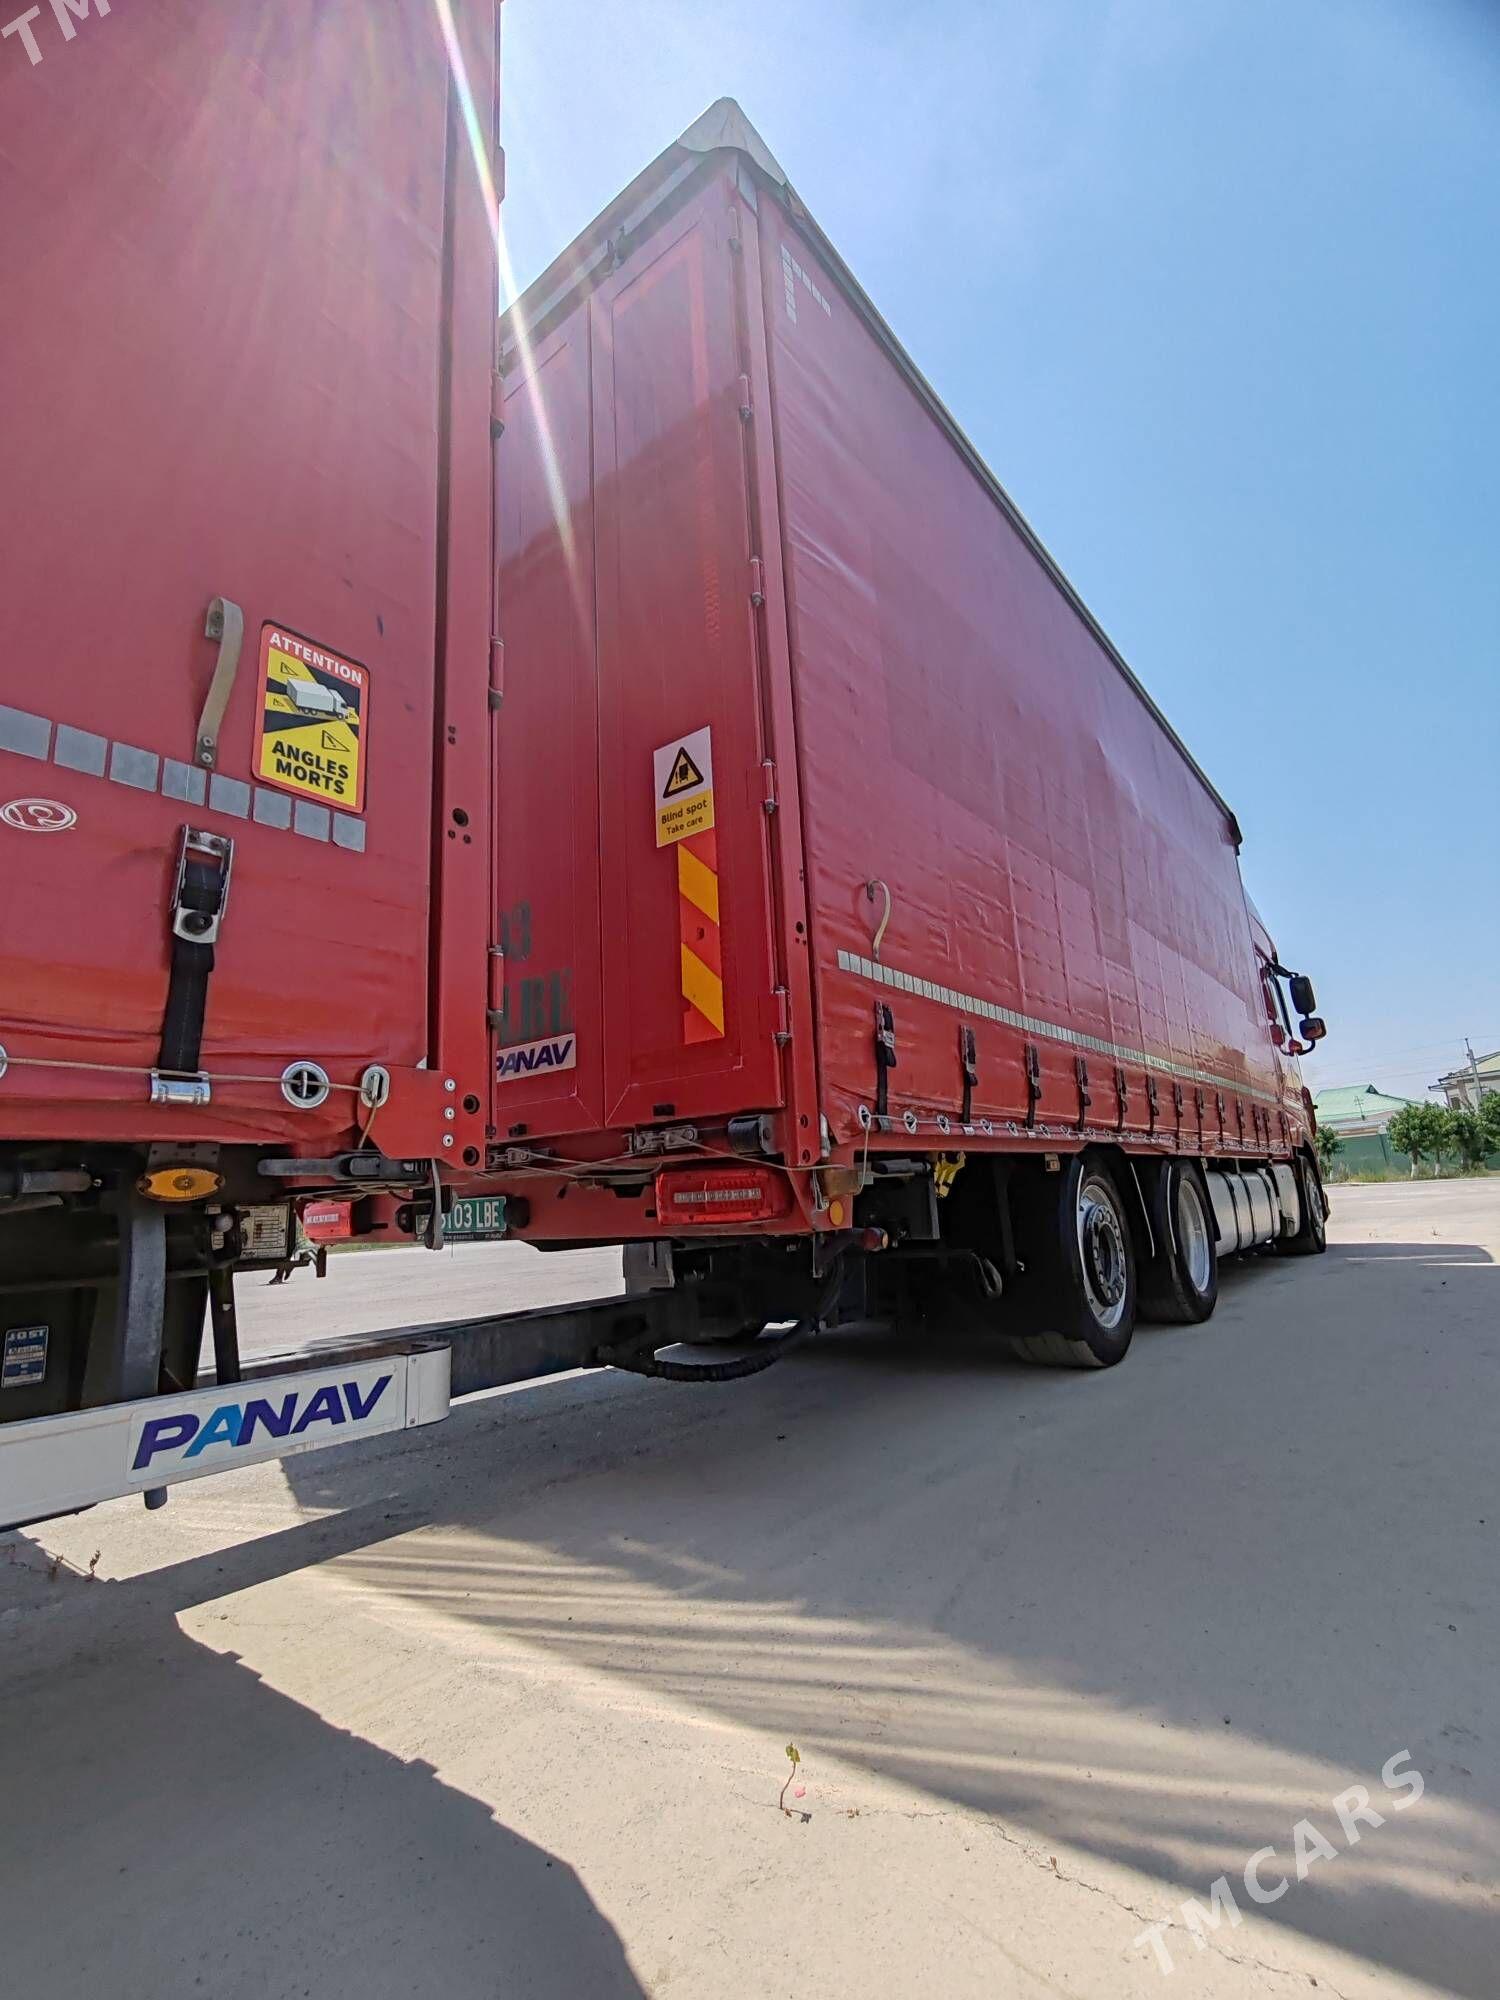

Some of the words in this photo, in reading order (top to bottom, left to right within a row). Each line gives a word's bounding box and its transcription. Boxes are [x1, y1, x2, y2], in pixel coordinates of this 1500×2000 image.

[270, 632, 362, 684] ATTENTION
[272, 740, 349, 779] ANGLES
[276, 758, 345, 795] MORTS
[662, 808, 684, 824] Blind
[686, 800, 708, 816] spot
[666, 823, 685, 835] Take
[686, 816, 704, 828] care
[476, 1201, 499, 1228] LBE
[132, 1374, 393, 1471] PANAV
